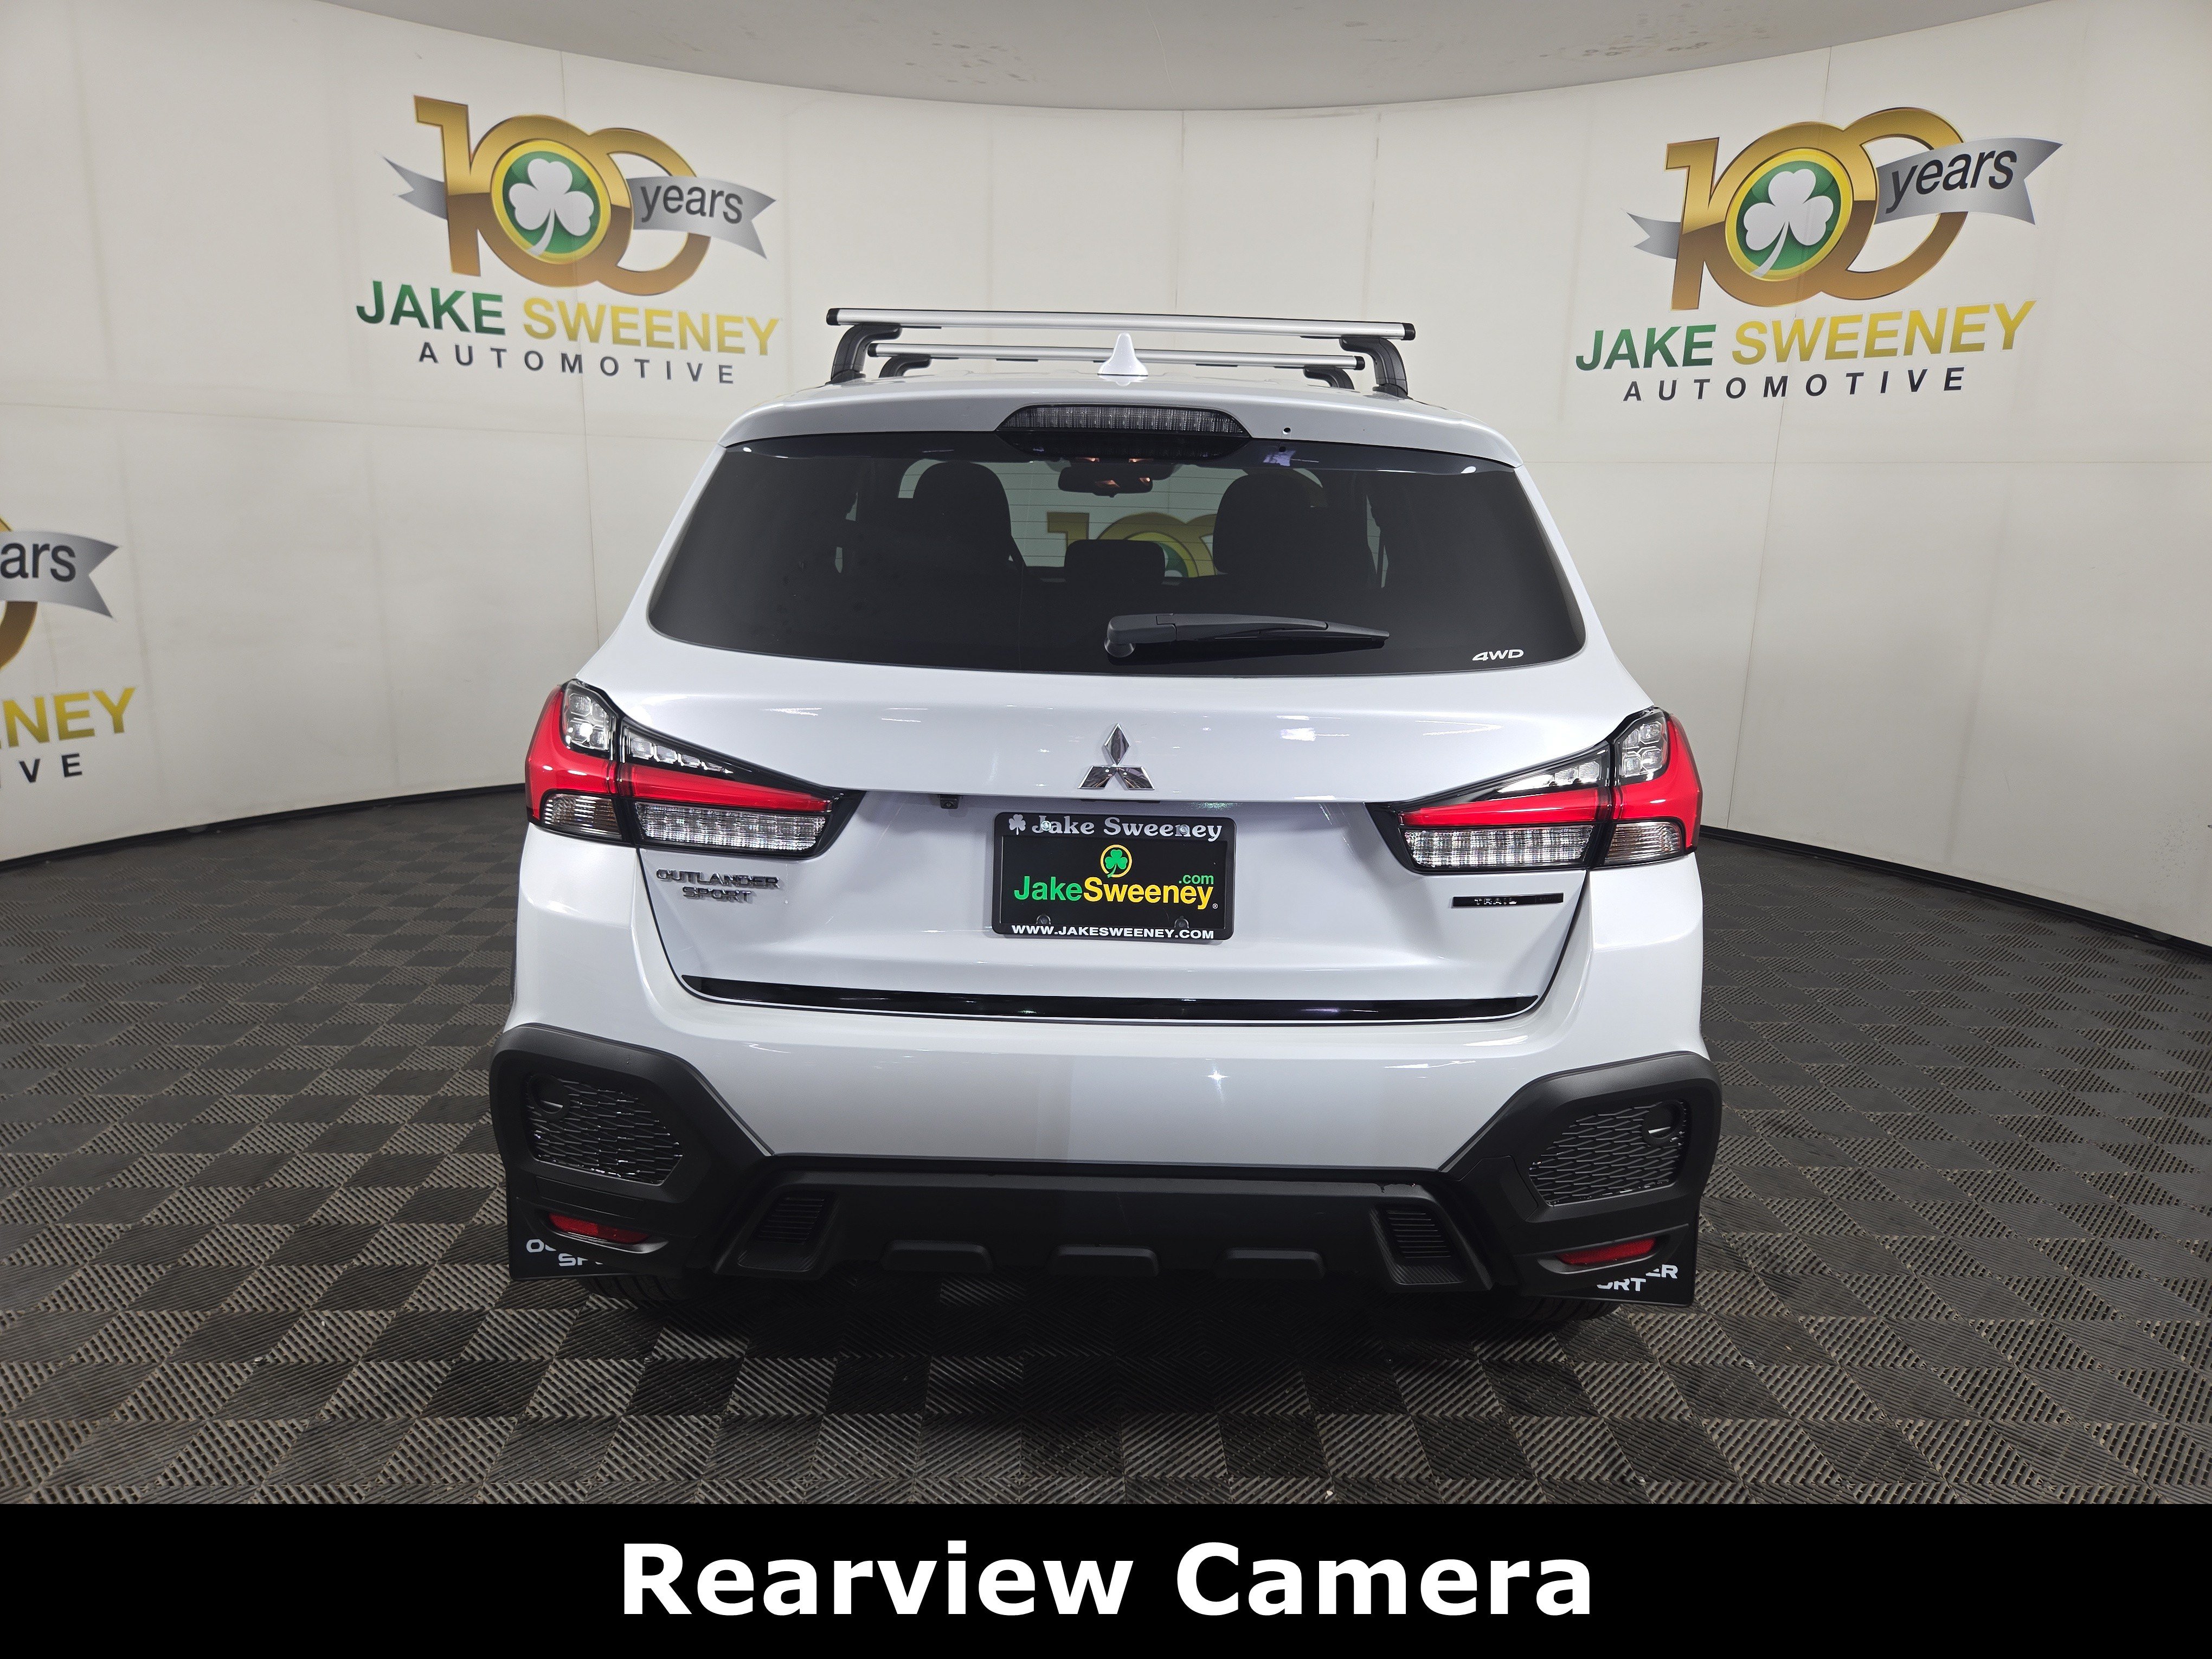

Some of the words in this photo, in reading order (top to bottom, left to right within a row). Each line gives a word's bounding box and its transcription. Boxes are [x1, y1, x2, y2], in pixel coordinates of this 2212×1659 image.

[1885, 150, 2017, 214] years
[641, 185, 742, 224] years
[356, 280, 505, 335] JAKE
[523, 297, 780, 356] SWEENEY
[1576, 324, 1716, 371] JAKE
[1732, 300, 2037, 365] SWEENEY
[419, 342, 734, 384] AUTOMOTIVE
[1623, 366, 1965, 401] AUTOMOTIVE
[0, 543, 76, 582] ars
[1472, 650, 1524, 661] 4WD
[1032, 815, 1095, 835] Jake
[1103, 818, 1223, 841] Sweeney
[656, 869, 780, 889] OUTLANDER
[683, 886, 753, 902] SPORT
[1012, 924, 1215, 940] WWW.JAKESWEENEY.COM
